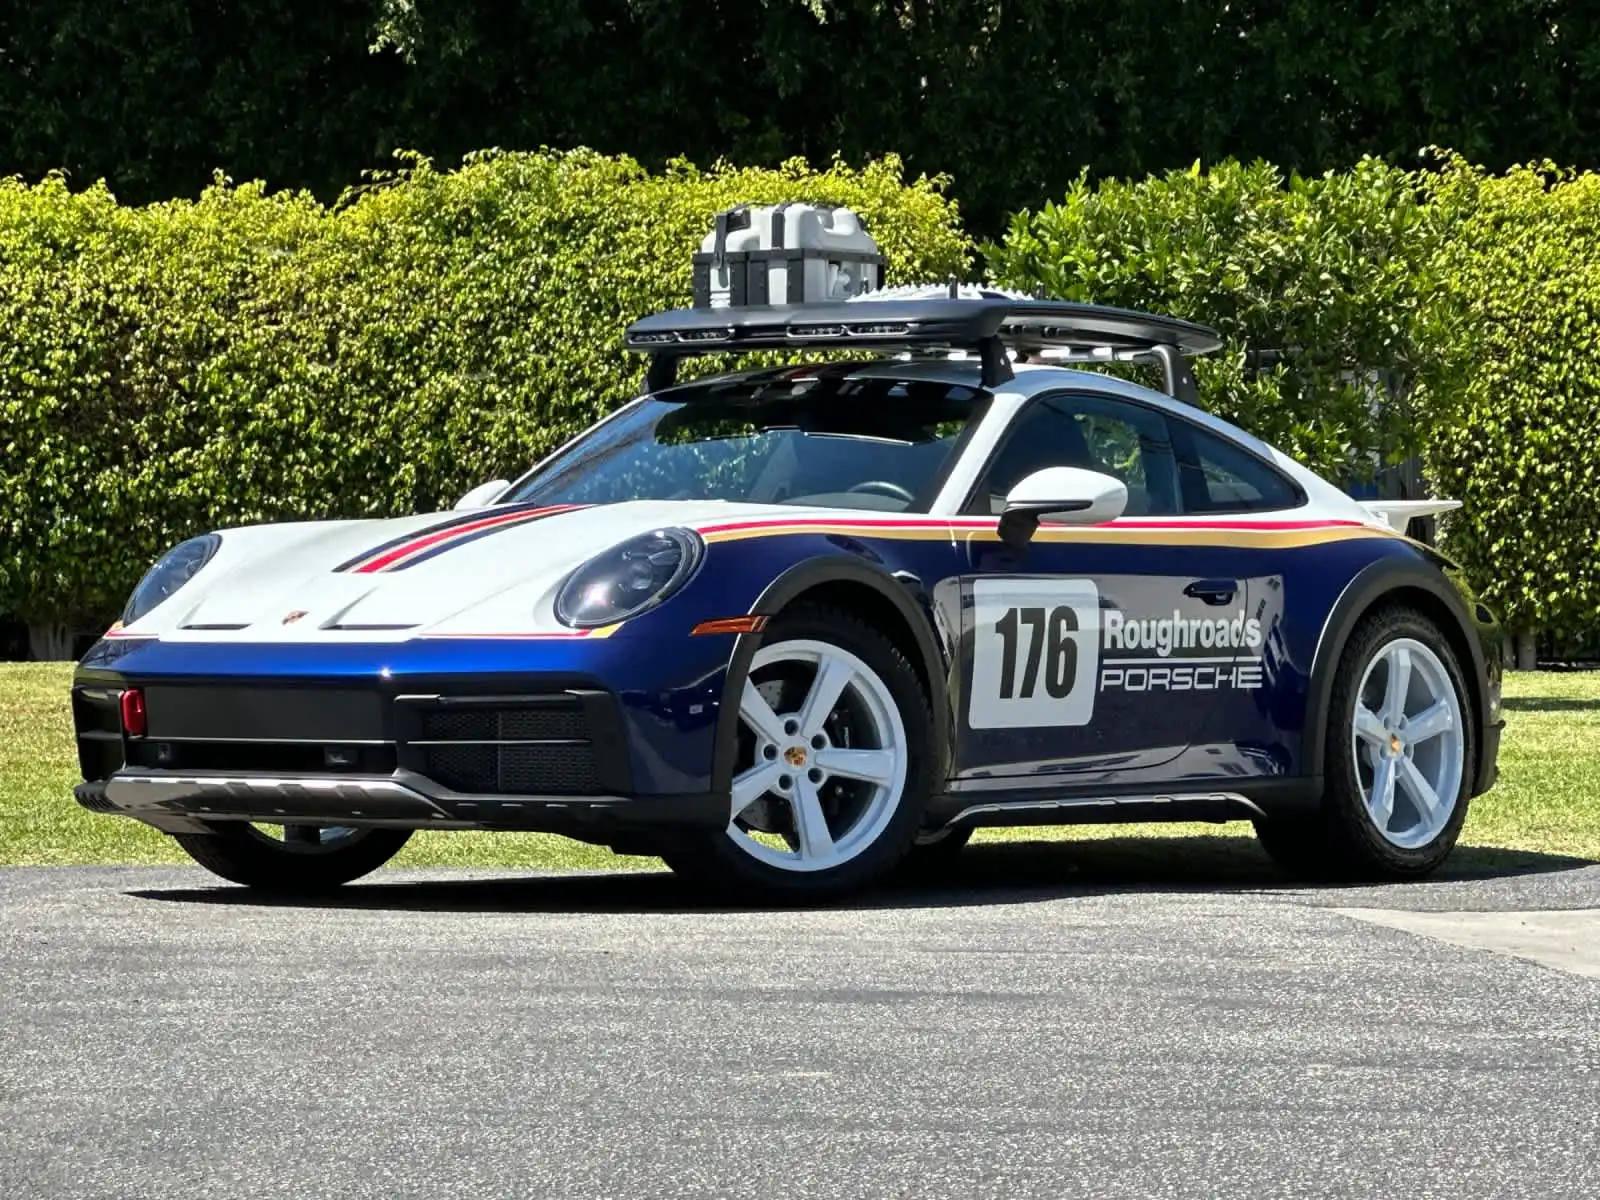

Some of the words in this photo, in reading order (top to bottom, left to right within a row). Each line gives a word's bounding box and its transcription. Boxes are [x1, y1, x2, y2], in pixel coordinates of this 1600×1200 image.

[995, 605, 1079, 699] 176
[1103, 609, 1261, 657] Roughroads
[1101, 666, 1262, 691] PORSCHE
